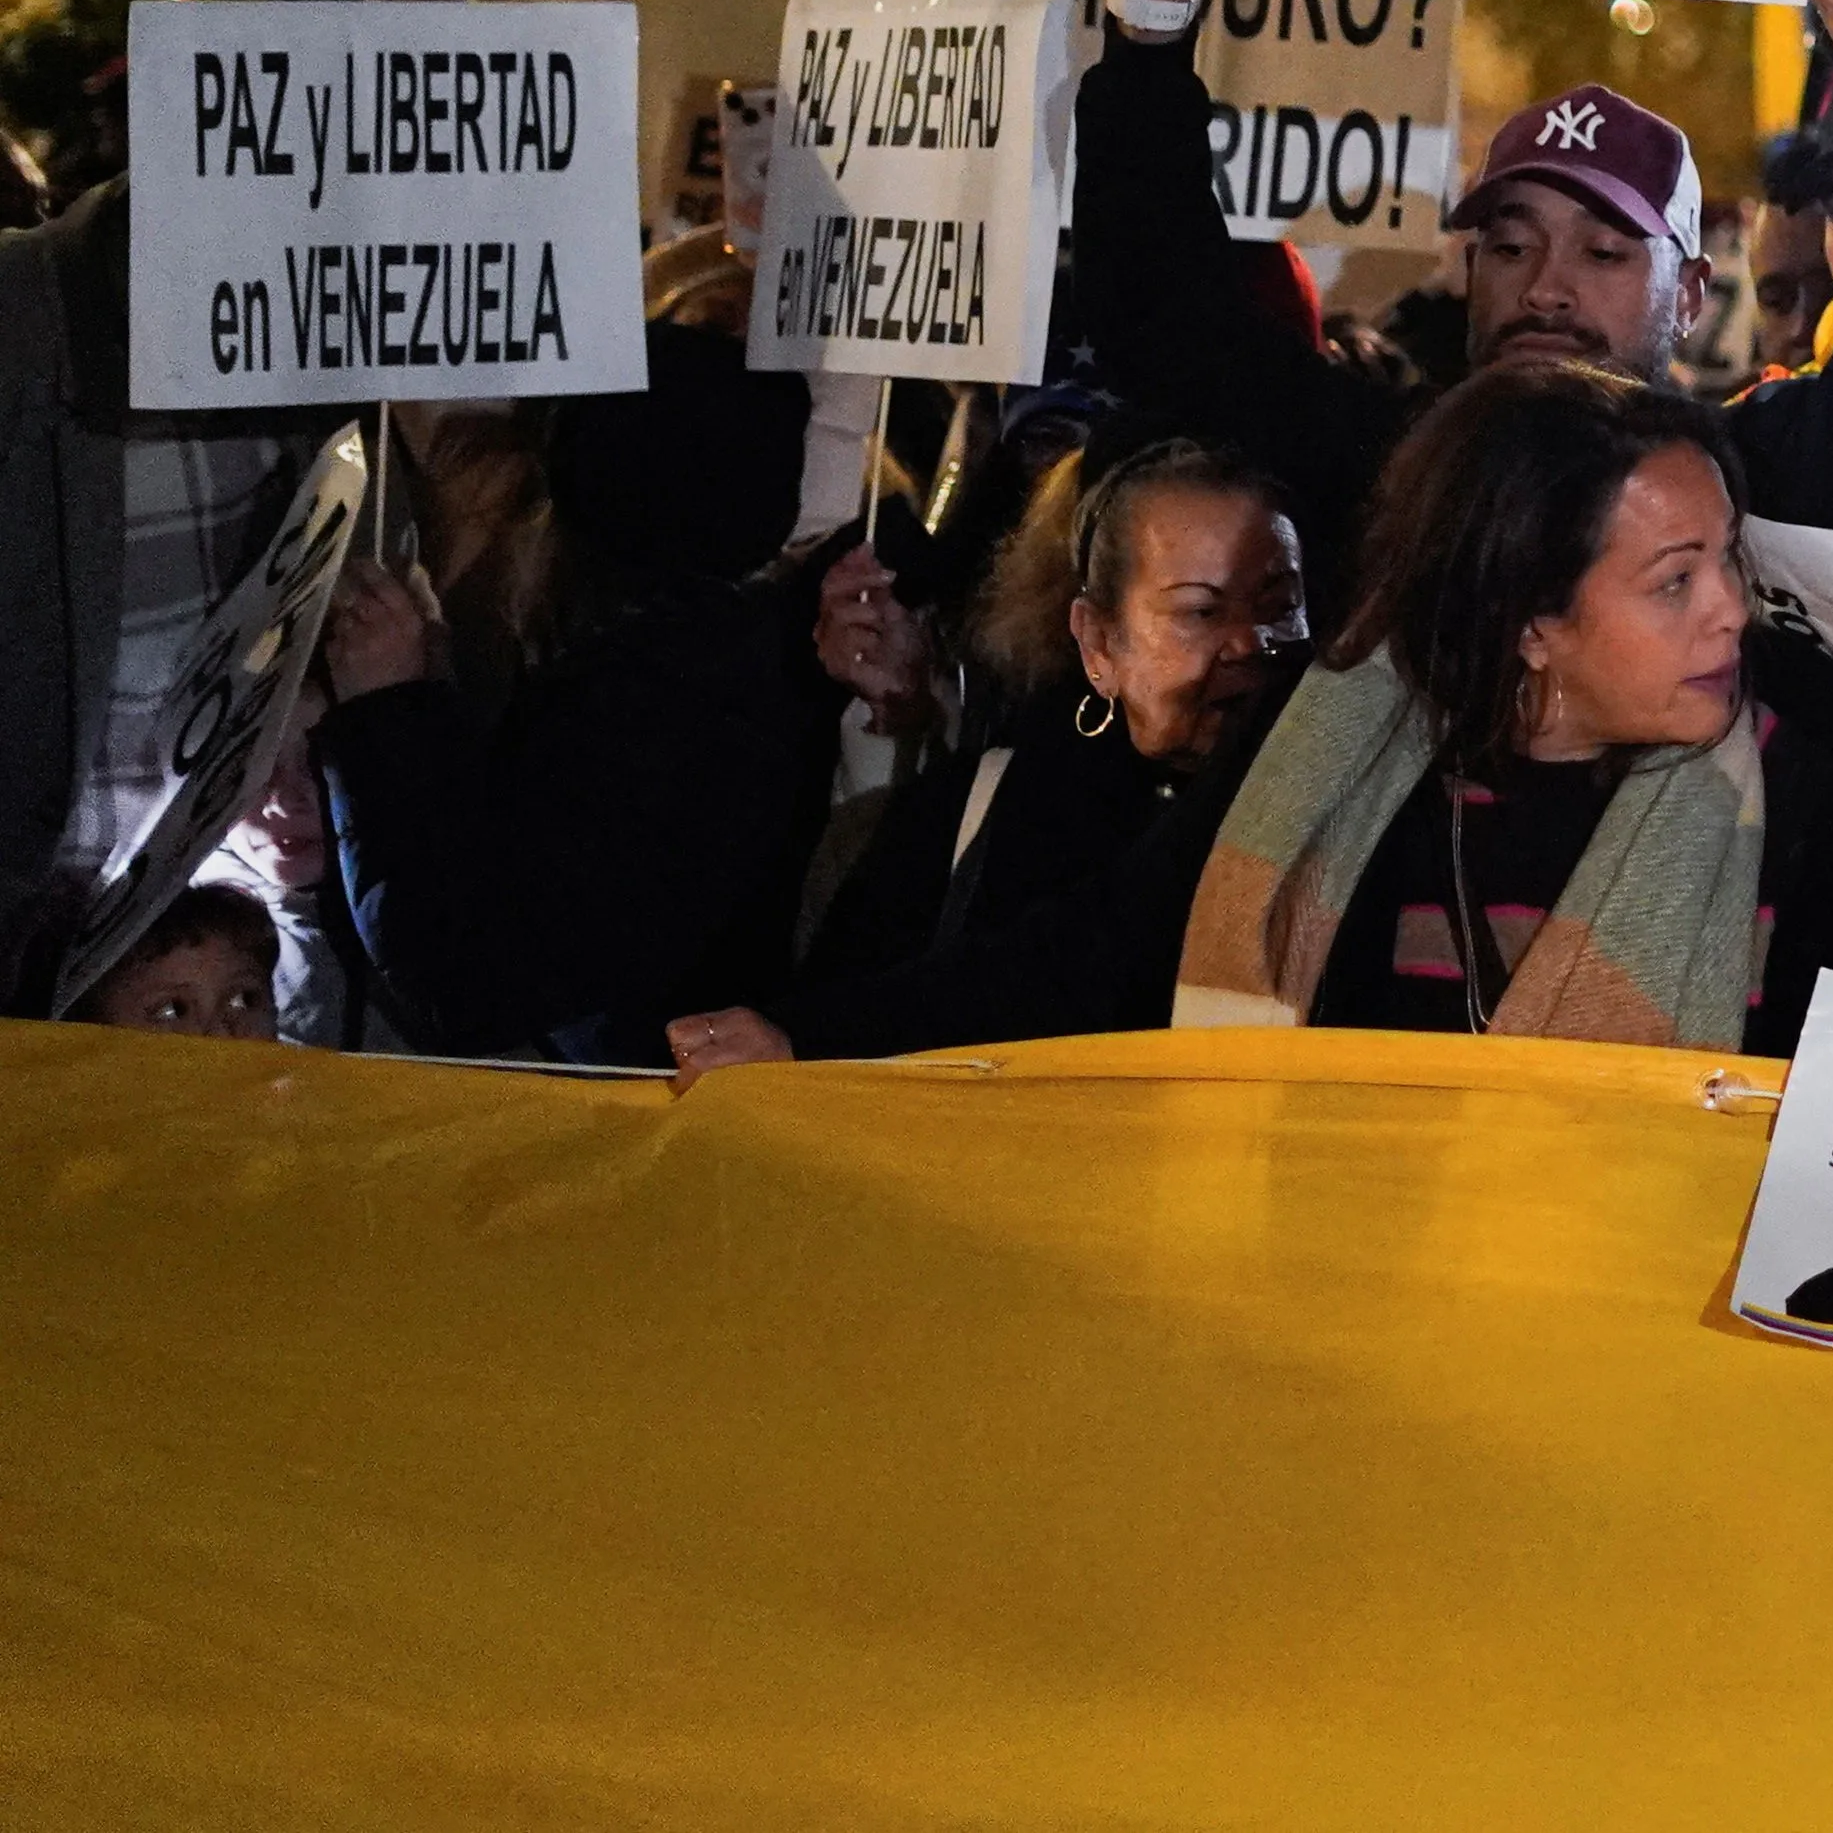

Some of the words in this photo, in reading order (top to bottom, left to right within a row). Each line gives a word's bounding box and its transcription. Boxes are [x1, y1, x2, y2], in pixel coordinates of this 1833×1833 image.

[195, 51, 294, 177] PAZ
[306, 84, 331, 210] y
[346, 51, 576, 174] LIBERTAD
[790, 27, 853, 148] PAZ
[836, 60, 871, 181] y
[866, 24, 1006, 150] LIBERTAD
[1535, 99, 1606, 151] NY
[211, 277, 271, 374] en
[285, 240, 569, 370] VENEZUELA
[776, 247, 805, 338] en
[806, 216, 985, 346] VENEZUELA
